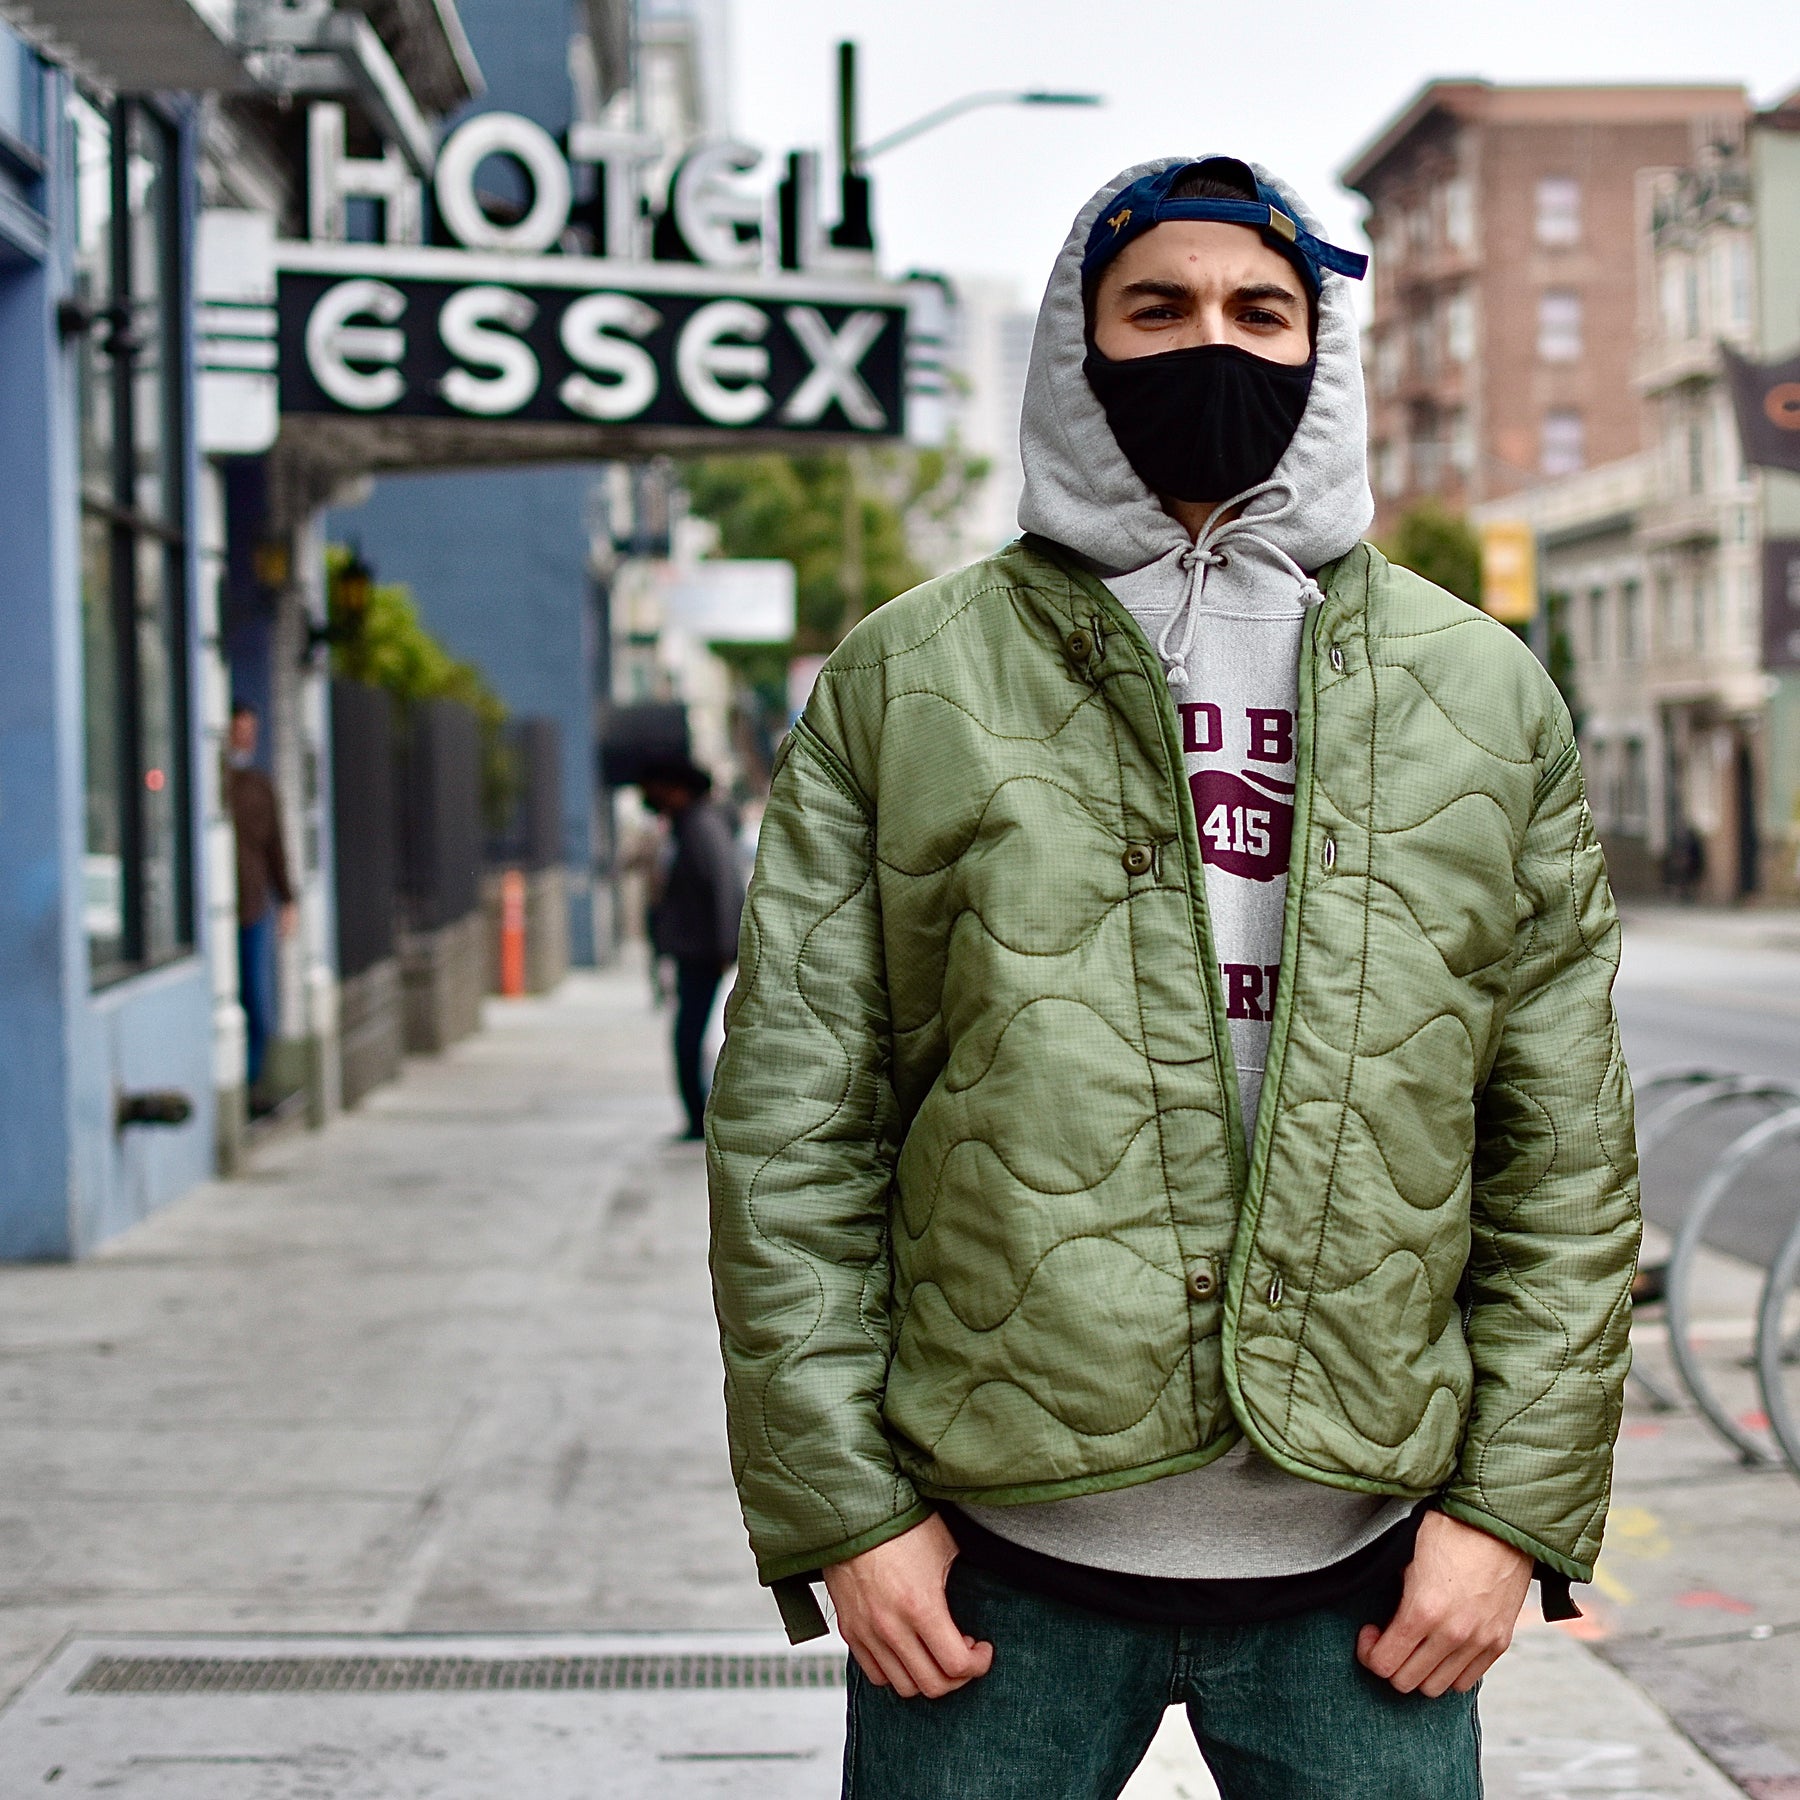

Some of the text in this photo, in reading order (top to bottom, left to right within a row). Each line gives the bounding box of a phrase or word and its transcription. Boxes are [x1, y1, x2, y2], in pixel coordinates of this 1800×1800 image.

[306, 102, 876, 276] HOTEL
[304, 279, 888, 429] ESSEX
[1245, 707, 1298, 764] B
[1202, 804, 1270, 857] 415
